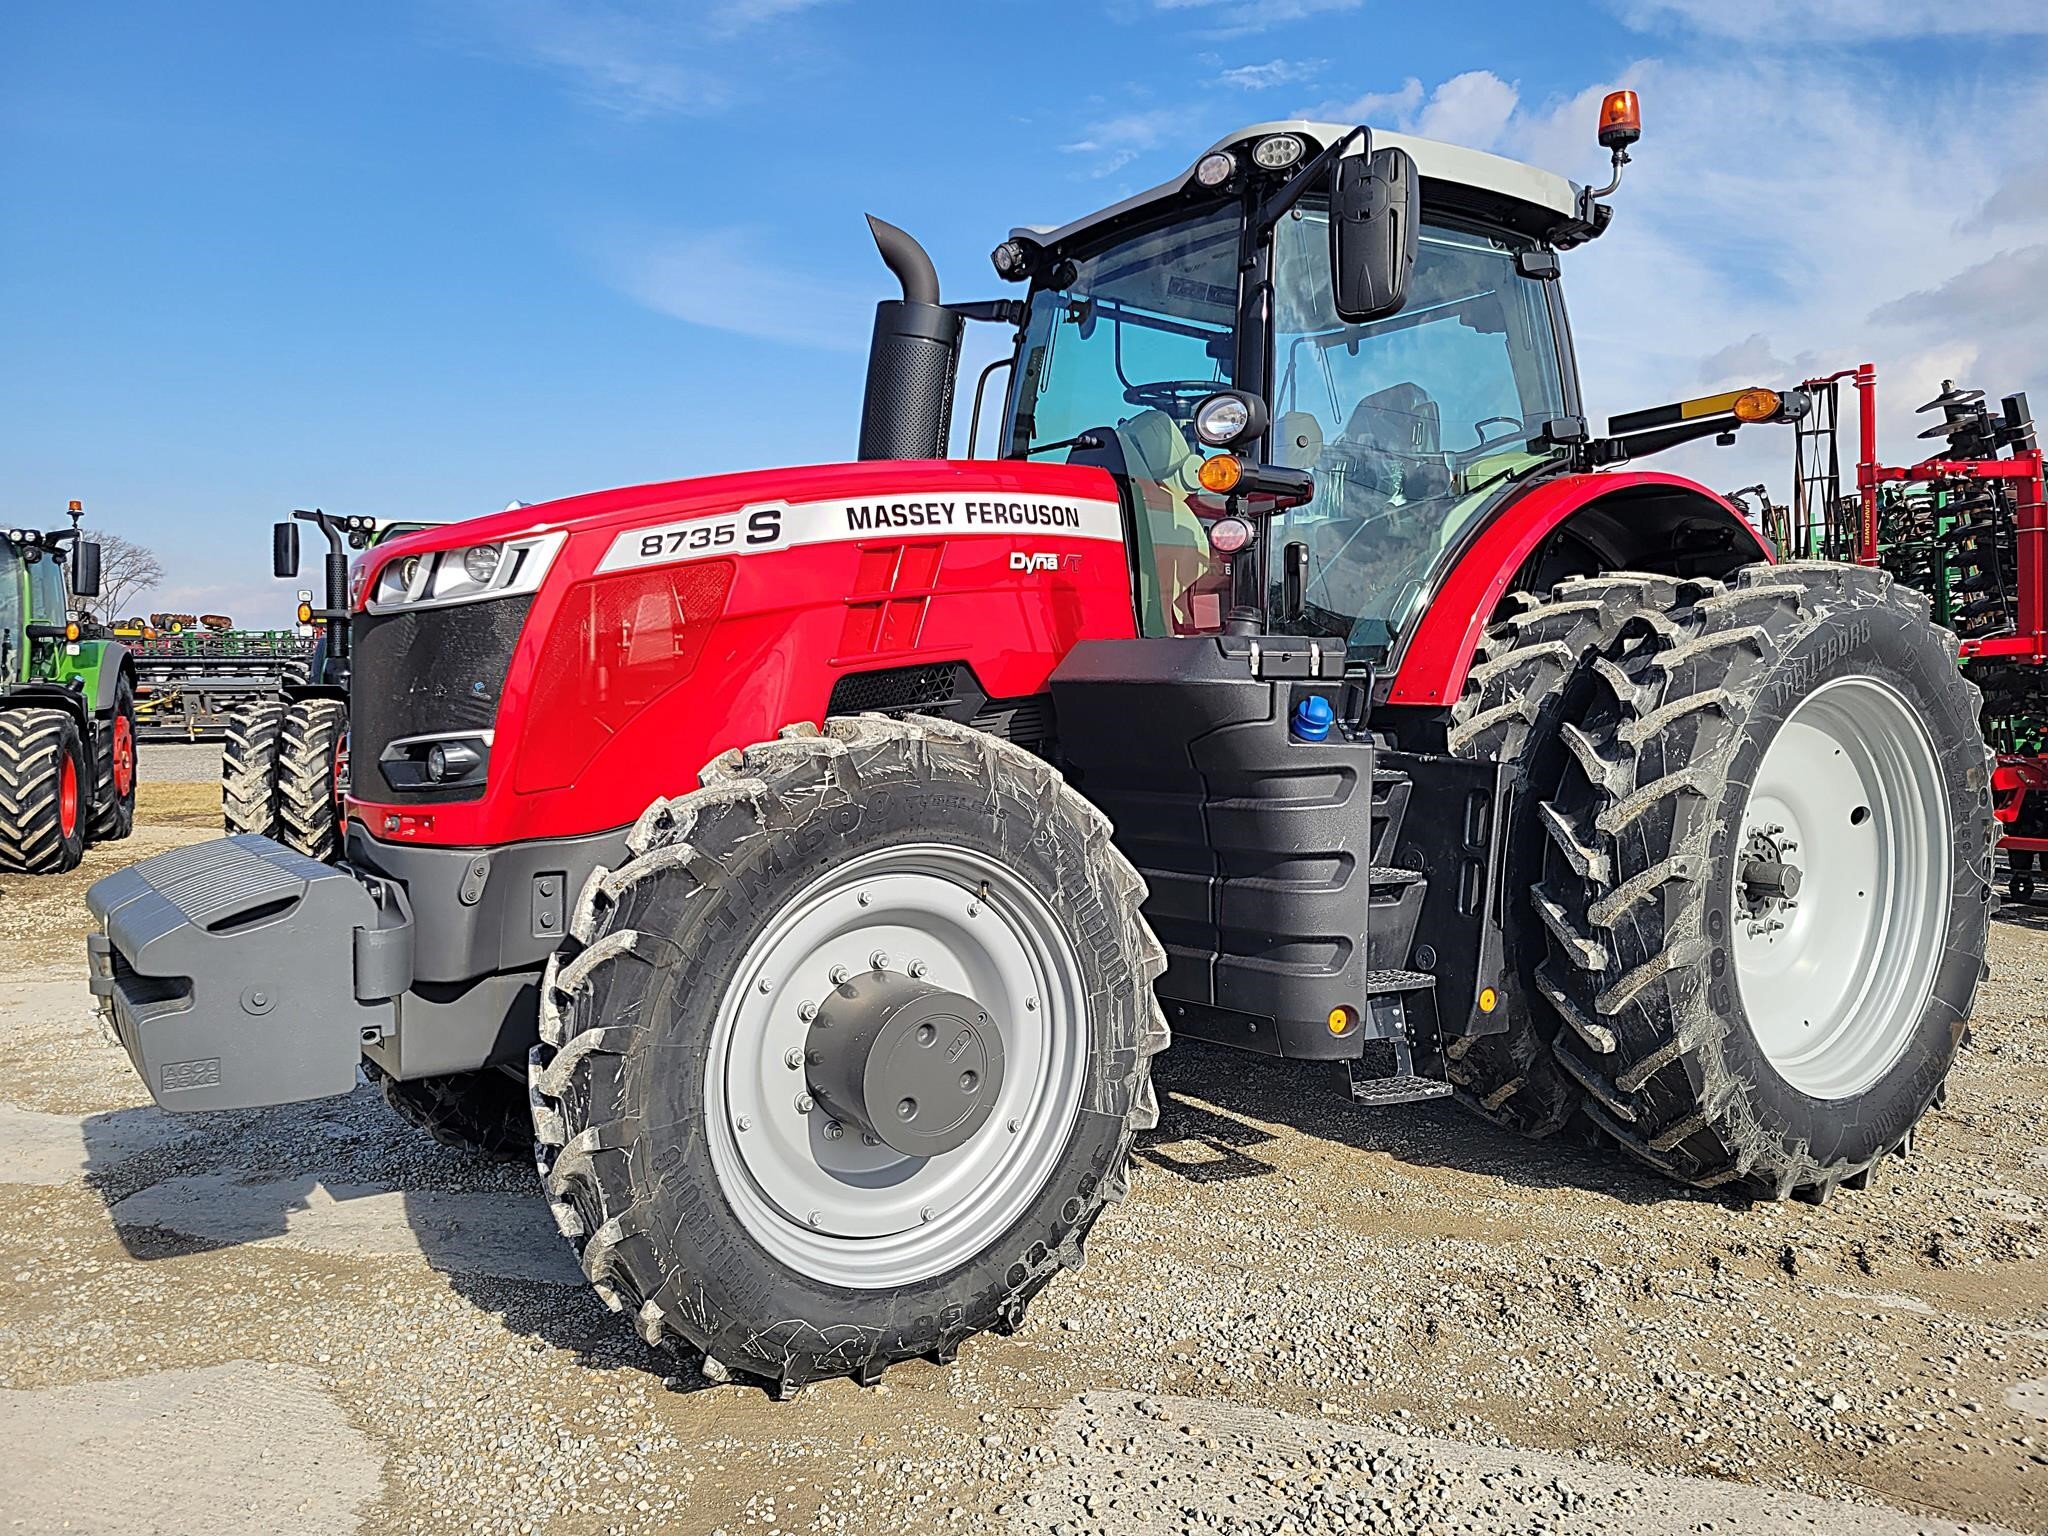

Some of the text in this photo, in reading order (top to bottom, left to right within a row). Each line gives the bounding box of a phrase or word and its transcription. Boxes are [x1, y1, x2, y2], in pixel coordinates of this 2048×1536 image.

[846, 502, 1080, 530] MASSEY FERGUSON
[640, 510, 782, 557] 8735 S
[1009, 551, 1060, 575] Dyna
[163, 1061, 218, 1078] AGCO
[650, 1144, 772, 1322] TRELLEBORG
